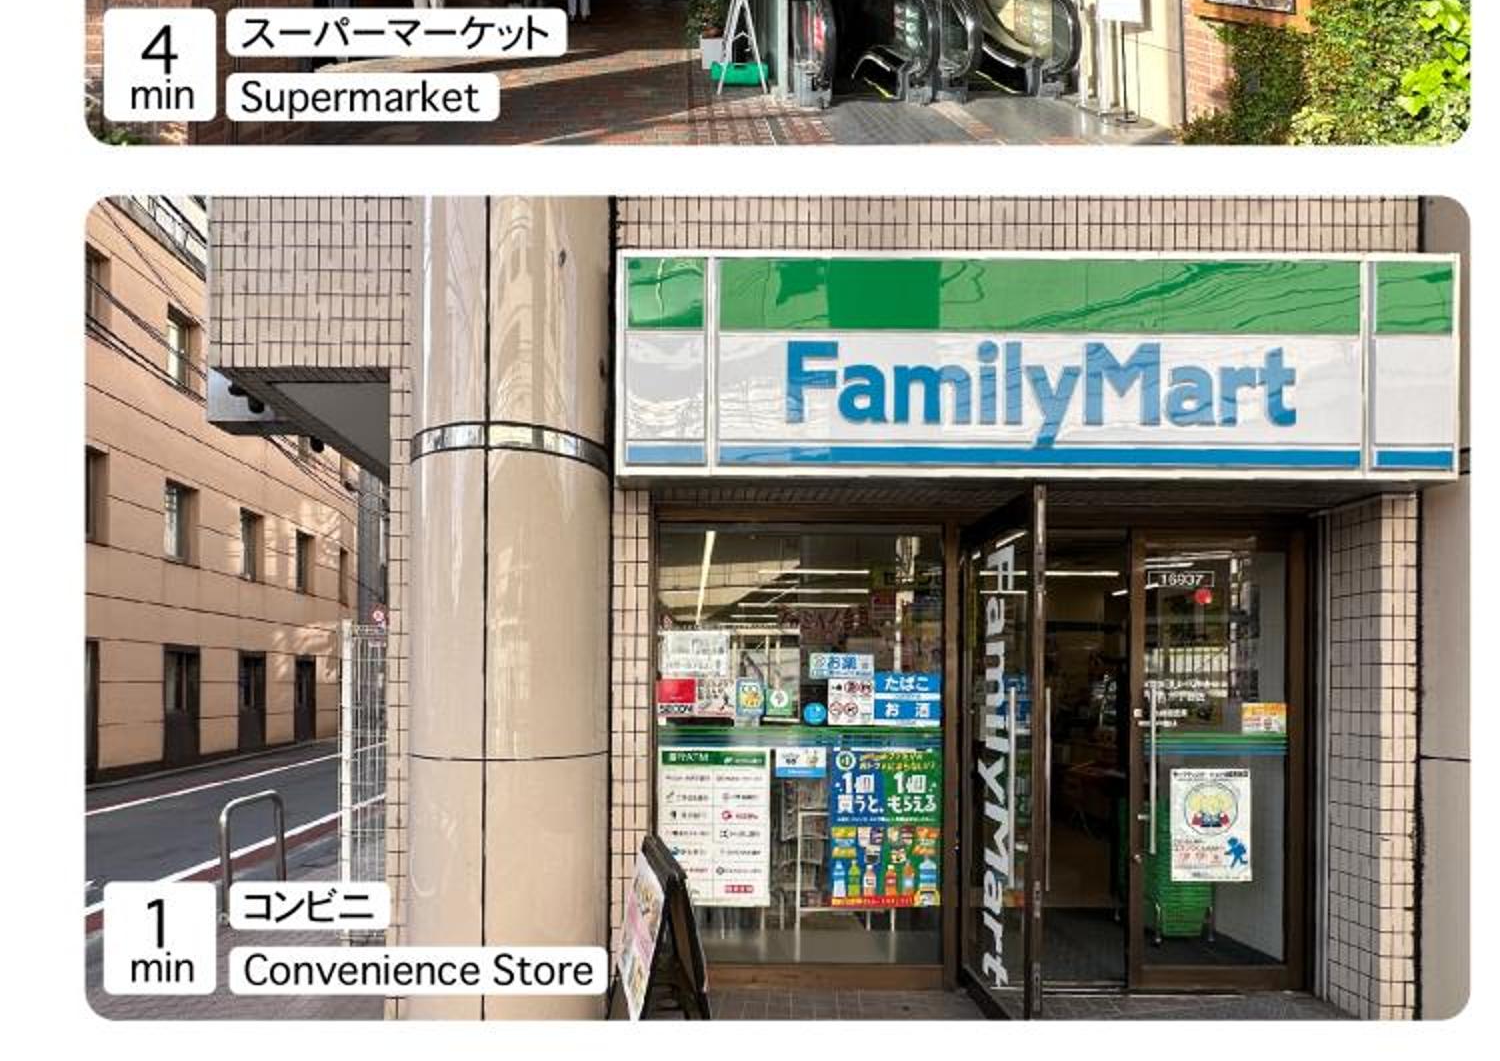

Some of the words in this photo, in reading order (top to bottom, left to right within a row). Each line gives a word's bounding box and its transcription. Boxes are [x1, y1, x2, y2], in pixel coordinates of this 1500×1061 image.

[785, 339, 1298, 451] FamilyMart
[884, 675, 929, 692] たばこ
[977, 543, 1015, 989] FamilyMart
